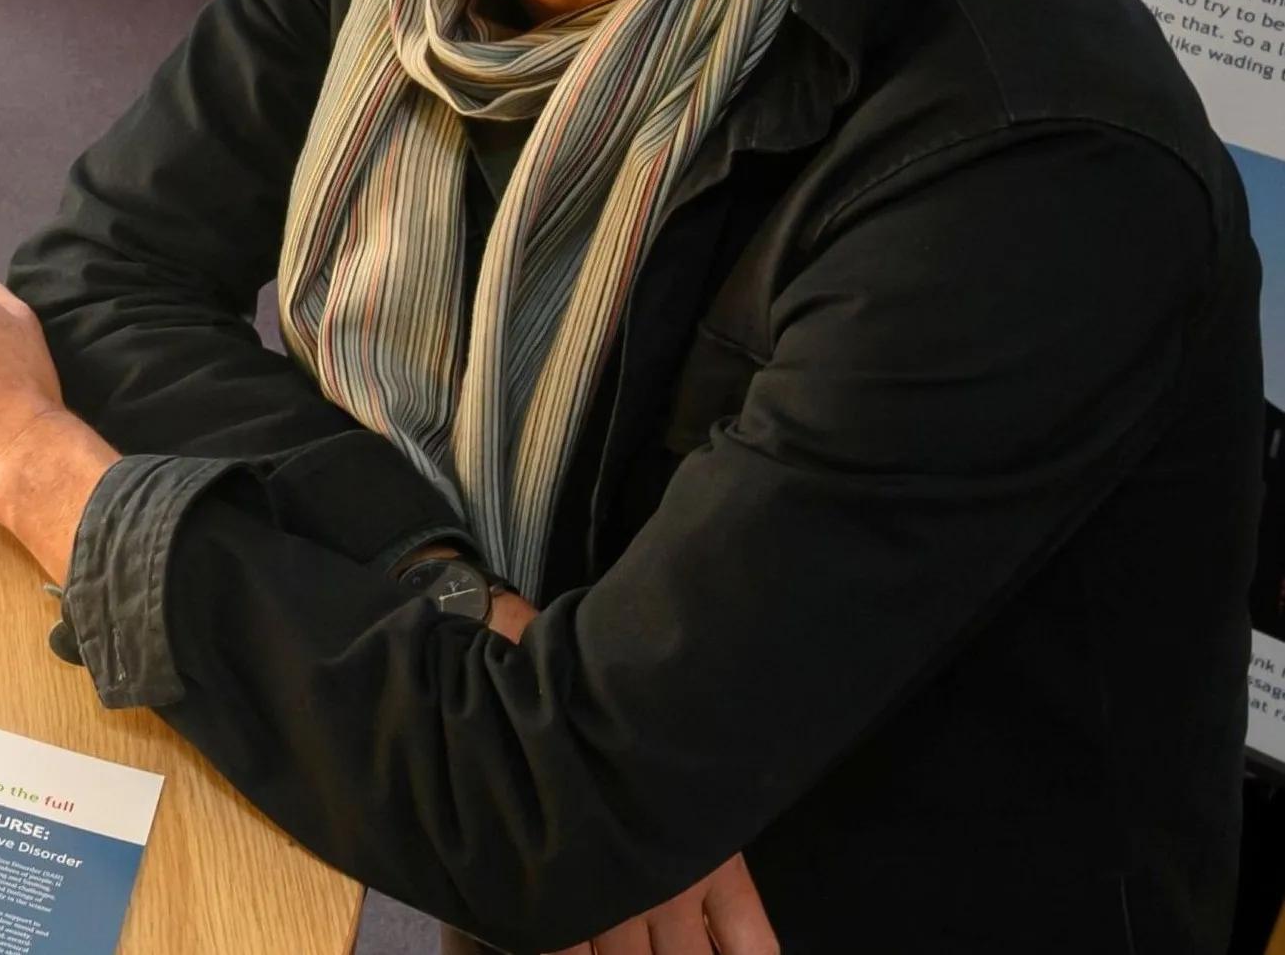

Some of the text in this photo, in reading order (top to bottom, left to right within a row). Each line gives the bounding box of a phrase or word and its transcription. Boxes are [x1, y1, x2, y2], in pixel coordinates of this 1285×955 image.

[1236, 6, 1255, 23] to
[1263, 14, 1285, 32] be
[1181, 15, 1224, 39] that.
[1233, 29, 1255, 47] So
[1260, 41, 1272, 53] a
[1169, 33, 1202, 55] like
[1208, 49, 1274, 81] wading
[11, 786, 39, 803] the
[44, 795, 75, 813] full
[18, 841, 84, 868] Disorder
